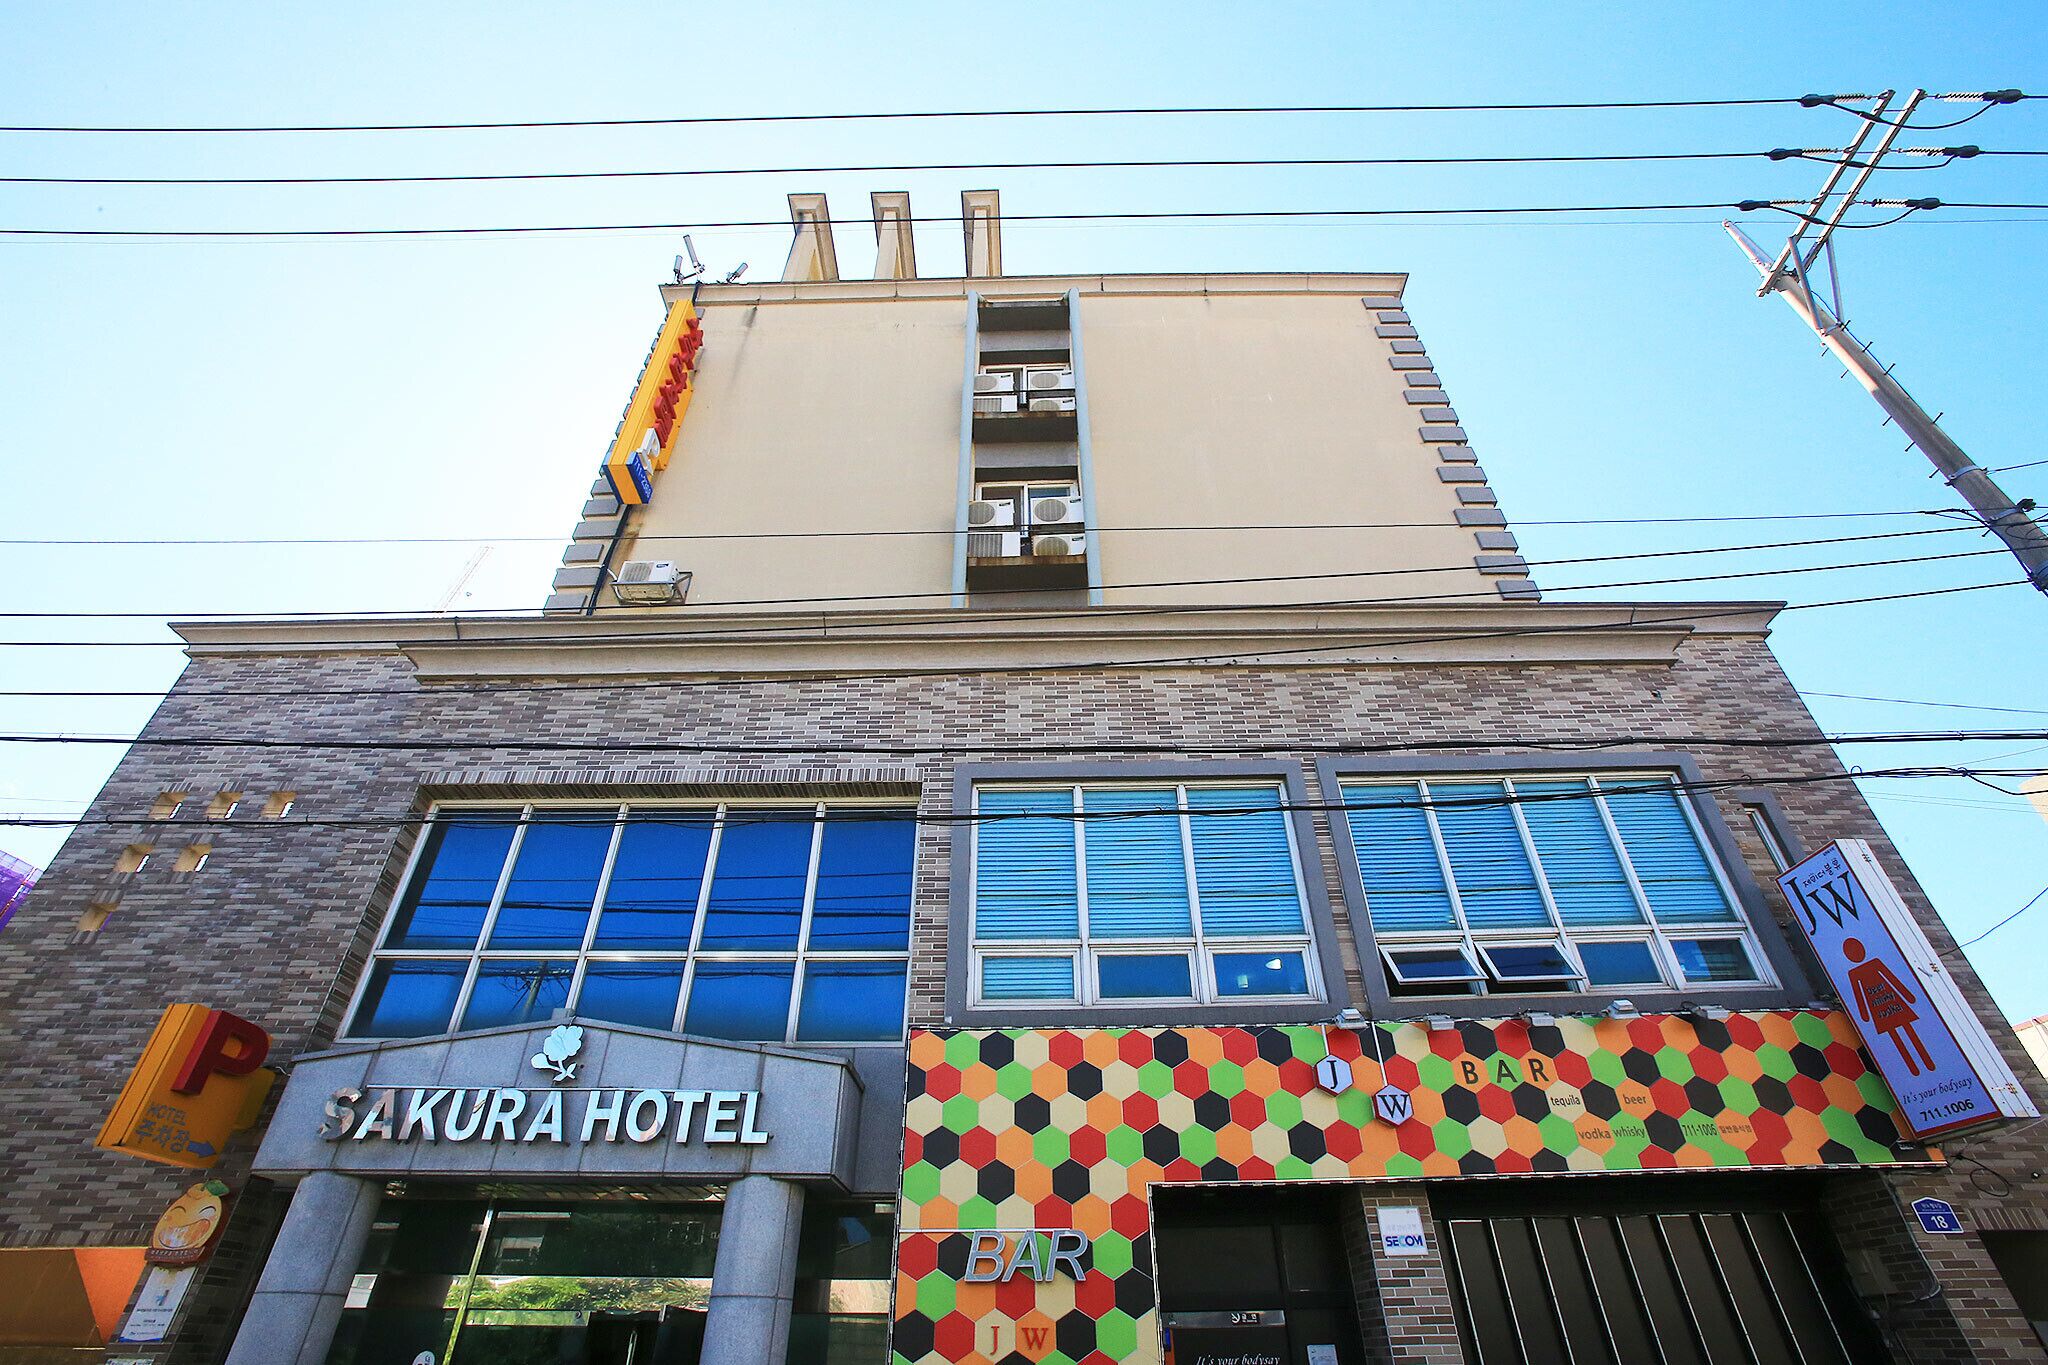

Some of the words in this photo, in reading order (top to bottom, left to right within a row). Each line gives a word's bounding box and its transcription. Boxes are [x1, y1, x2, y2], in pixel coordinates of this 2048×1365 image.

[1784, 870, 1860, 935] JW
[171, 1010, 270, 1095] P
[1461, 1058, 1549, 1084] BAR
[1326, 1060, 1338, 1089] J
[1377, 1094, 1409, 1118] W
[1550, 1094, 1581, 1107] tequila
[1623, 1094, 1647, 1104] beer
[1919, 1087, 1937, 1103] your
[1938, 1077, 1973, 1094] bodysay
[318, 1087, 563, 1143] SAKURA
[580, 1090, 770, 1145] HOTEL
[1578, 1127, 1612, 1139] vodka
[1613, 1125, 1645, 1138] whisky
[1681, 1123, 1718, 1137] 711-1006
[1930, 1215, 1949, 1229] 18
[1385, 1235, 1424, 1247] SECOM
[964, 1229, 1088, 1283] BAR
